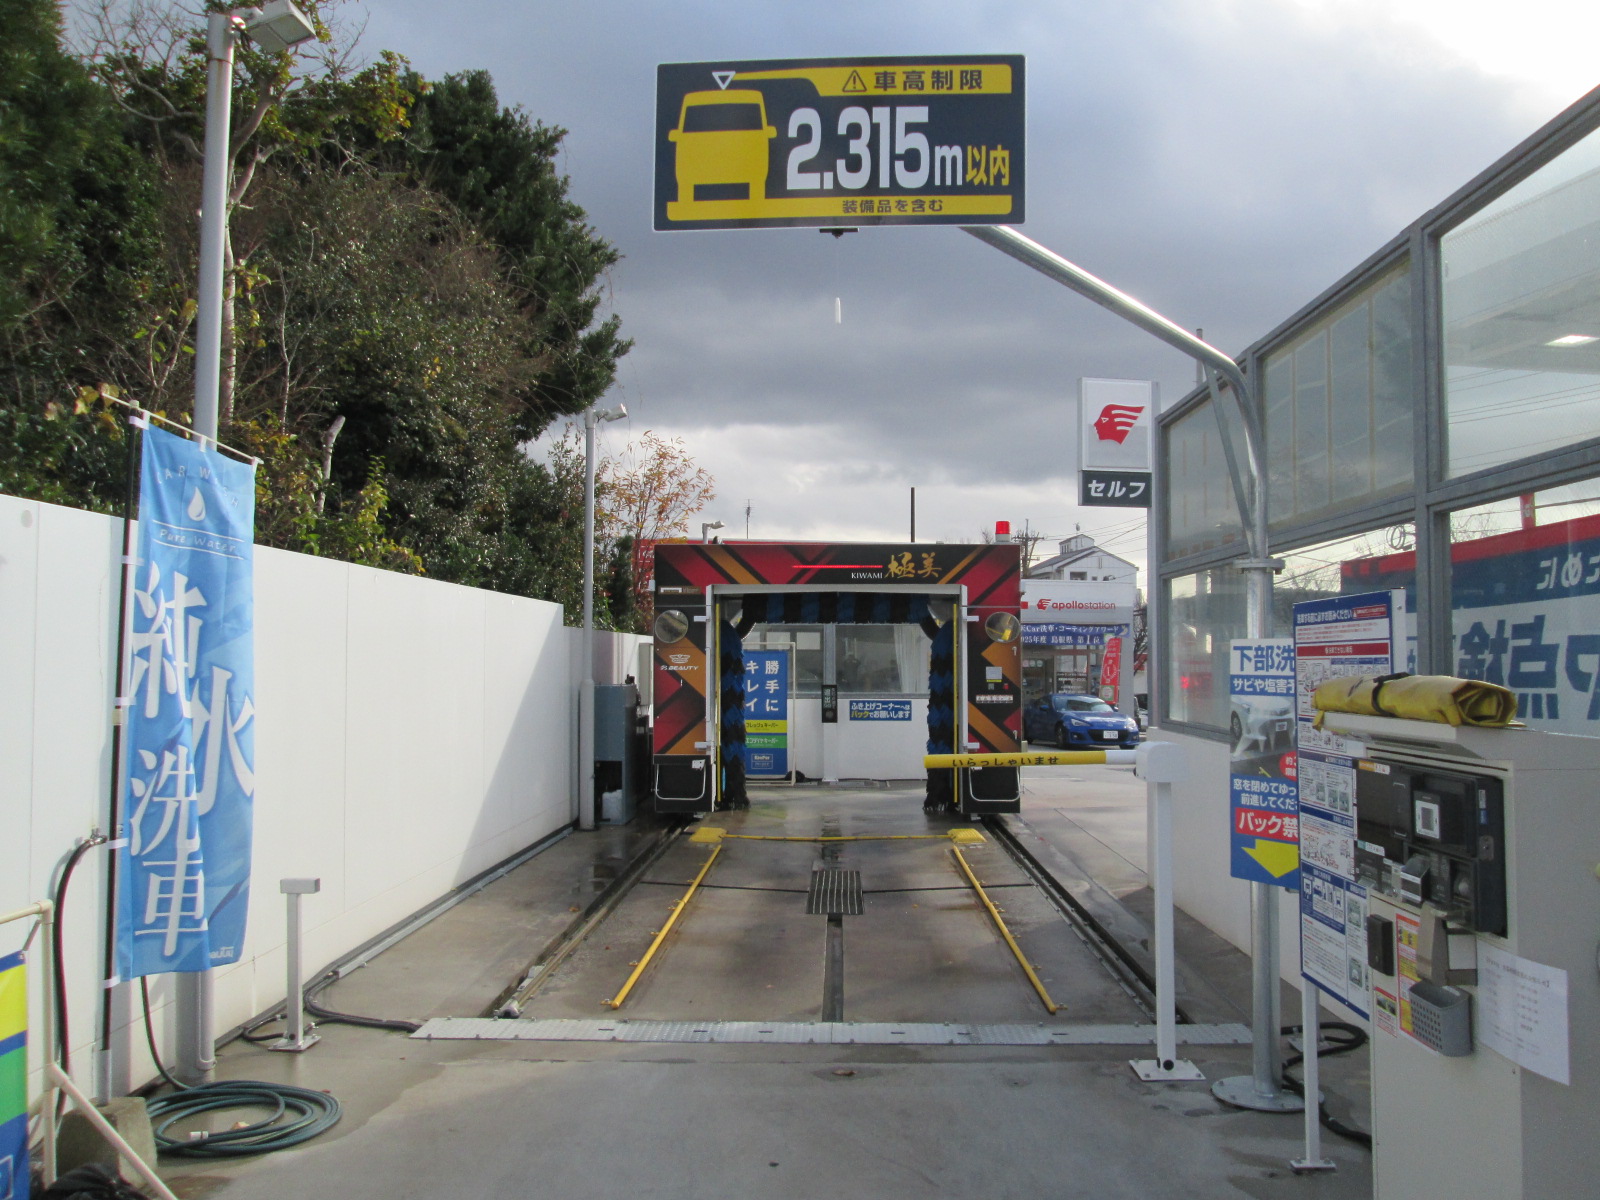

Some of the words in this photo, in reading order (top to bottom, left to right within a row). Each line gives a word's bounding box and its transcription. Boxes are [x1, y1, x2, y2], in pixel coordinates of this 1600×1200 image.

[874, 70, 983, 91] 車高制限
[842, 199, 944, 214] 装備品を含む
[1088, 479, 1146, 498] セルフ
[160, 528, 186, 544] Pure
[194, 535, 236, 552] Water
[884, 551, 942, 578] 極美
[1051, 600, 1116, 611] apollostation
[1233, 645, 1295, 673] 下部洗
[746, 660, 759, 712] キレイ
[765, 660, 779, 711] 勝手に
[851, 702, 911, 710] ふき上げコーナーへは
[851, 710, 911, 719] バックでお願いします
[952, 756, 1059, 767] いらっしゃいませ
[1233, 778, 1297, 796] 窓を閉めてゆっ
[1241, 793, 1298, 811] 前進してくだ
[1239, 812, 1299, 839] バック禁
